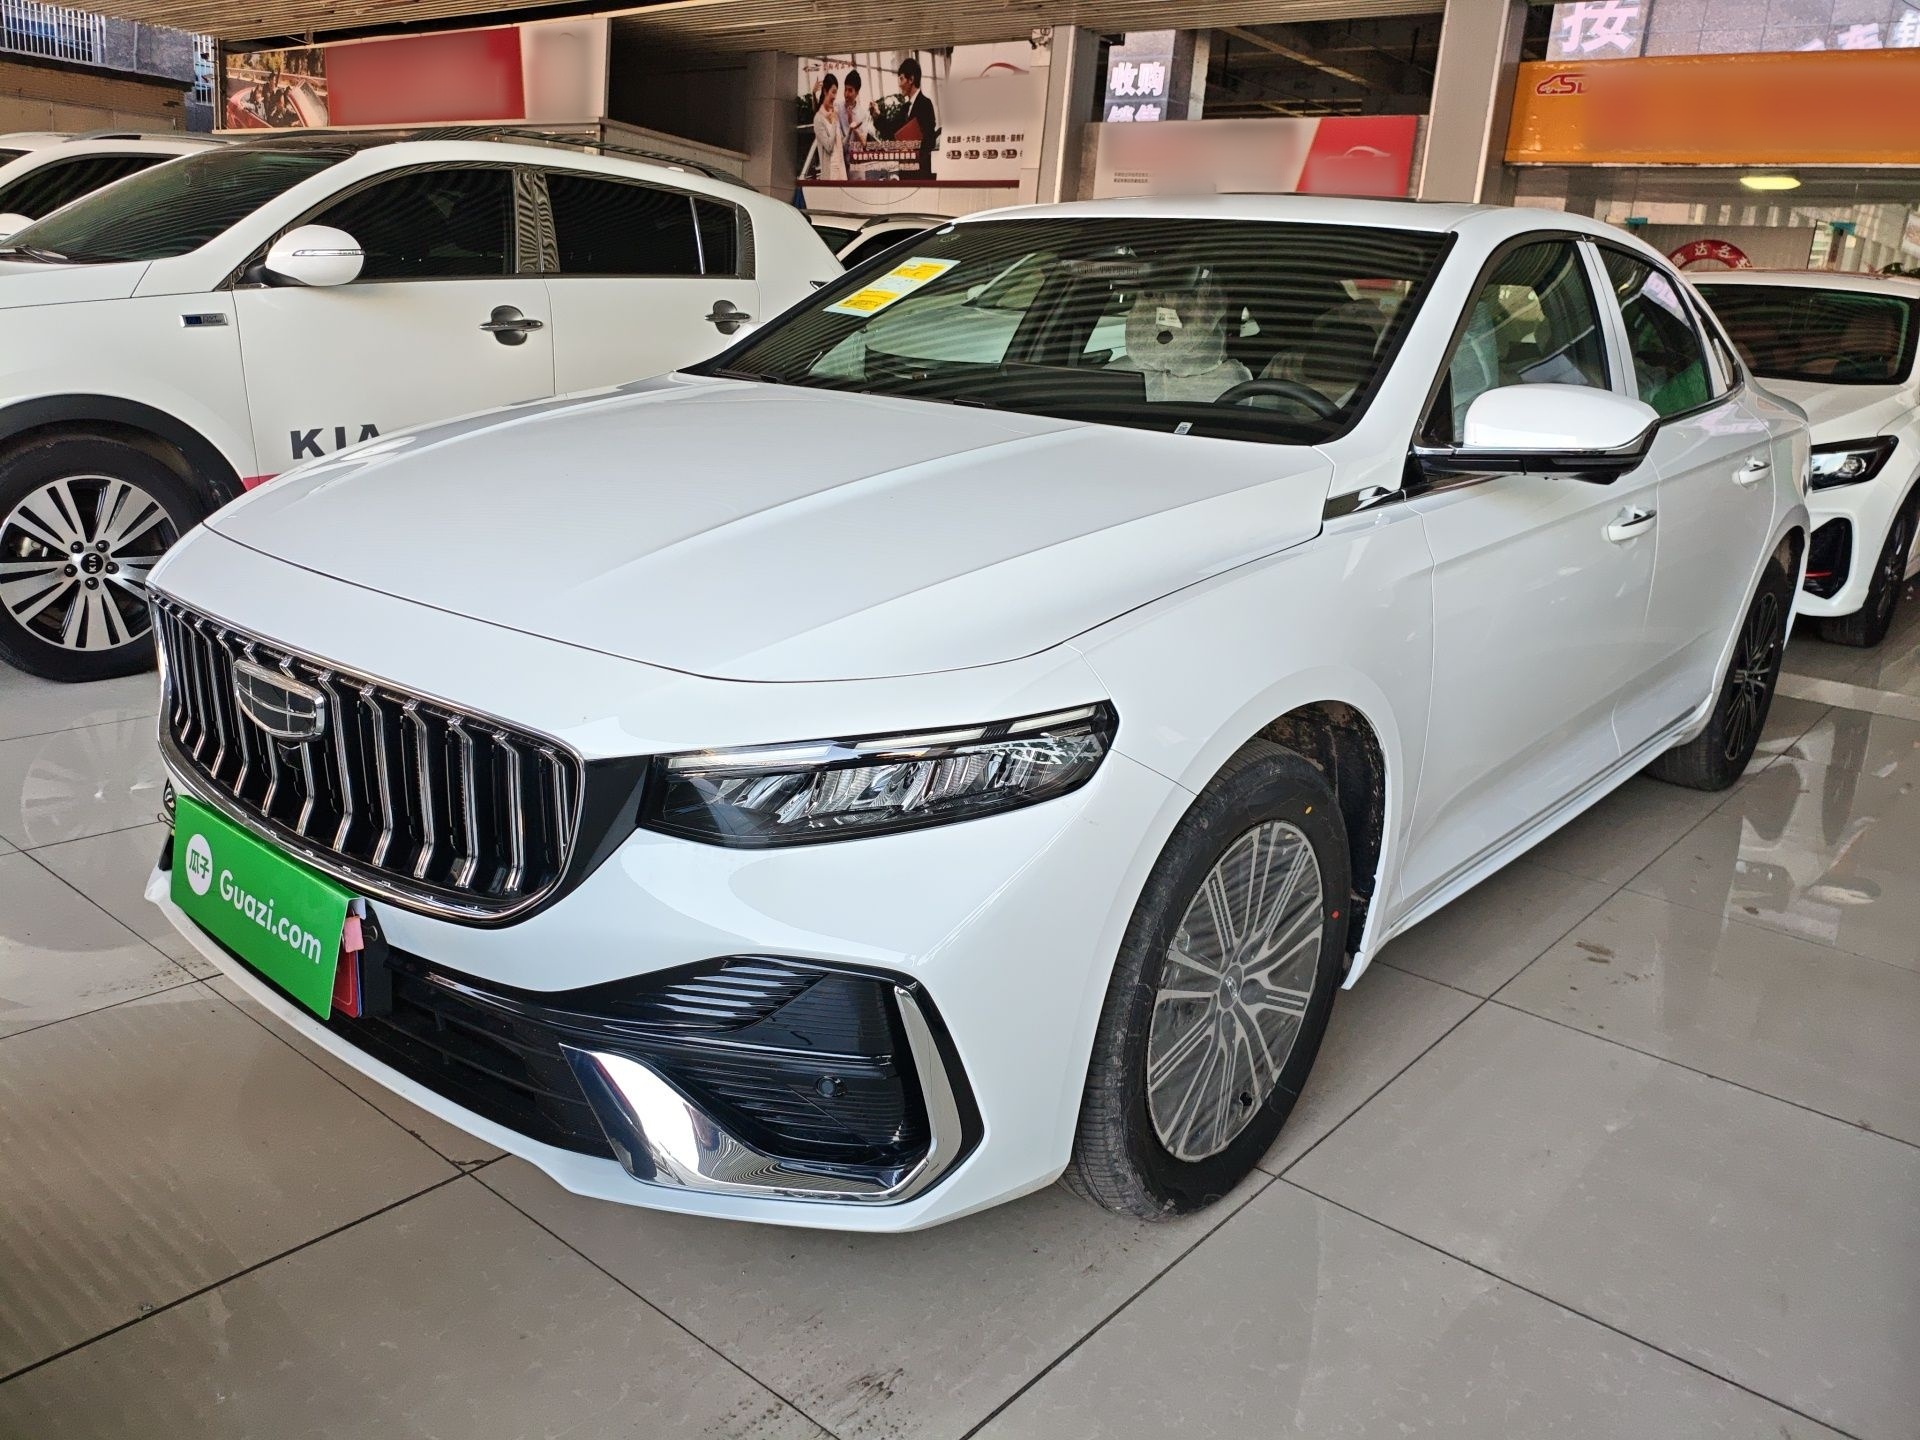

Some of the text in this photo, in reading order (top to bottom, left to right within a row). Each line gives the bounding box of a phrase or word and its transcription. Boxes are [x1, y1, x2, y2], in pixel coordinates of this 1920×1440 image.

[1560, 0, 1640, 53] 按
[1109, 61, 1166, 97] 收购
[89, 555, 97, 572] KIA
[188, 848, 211, 880] 瓜子
[219, 869, 322, 965] Guazi.com
